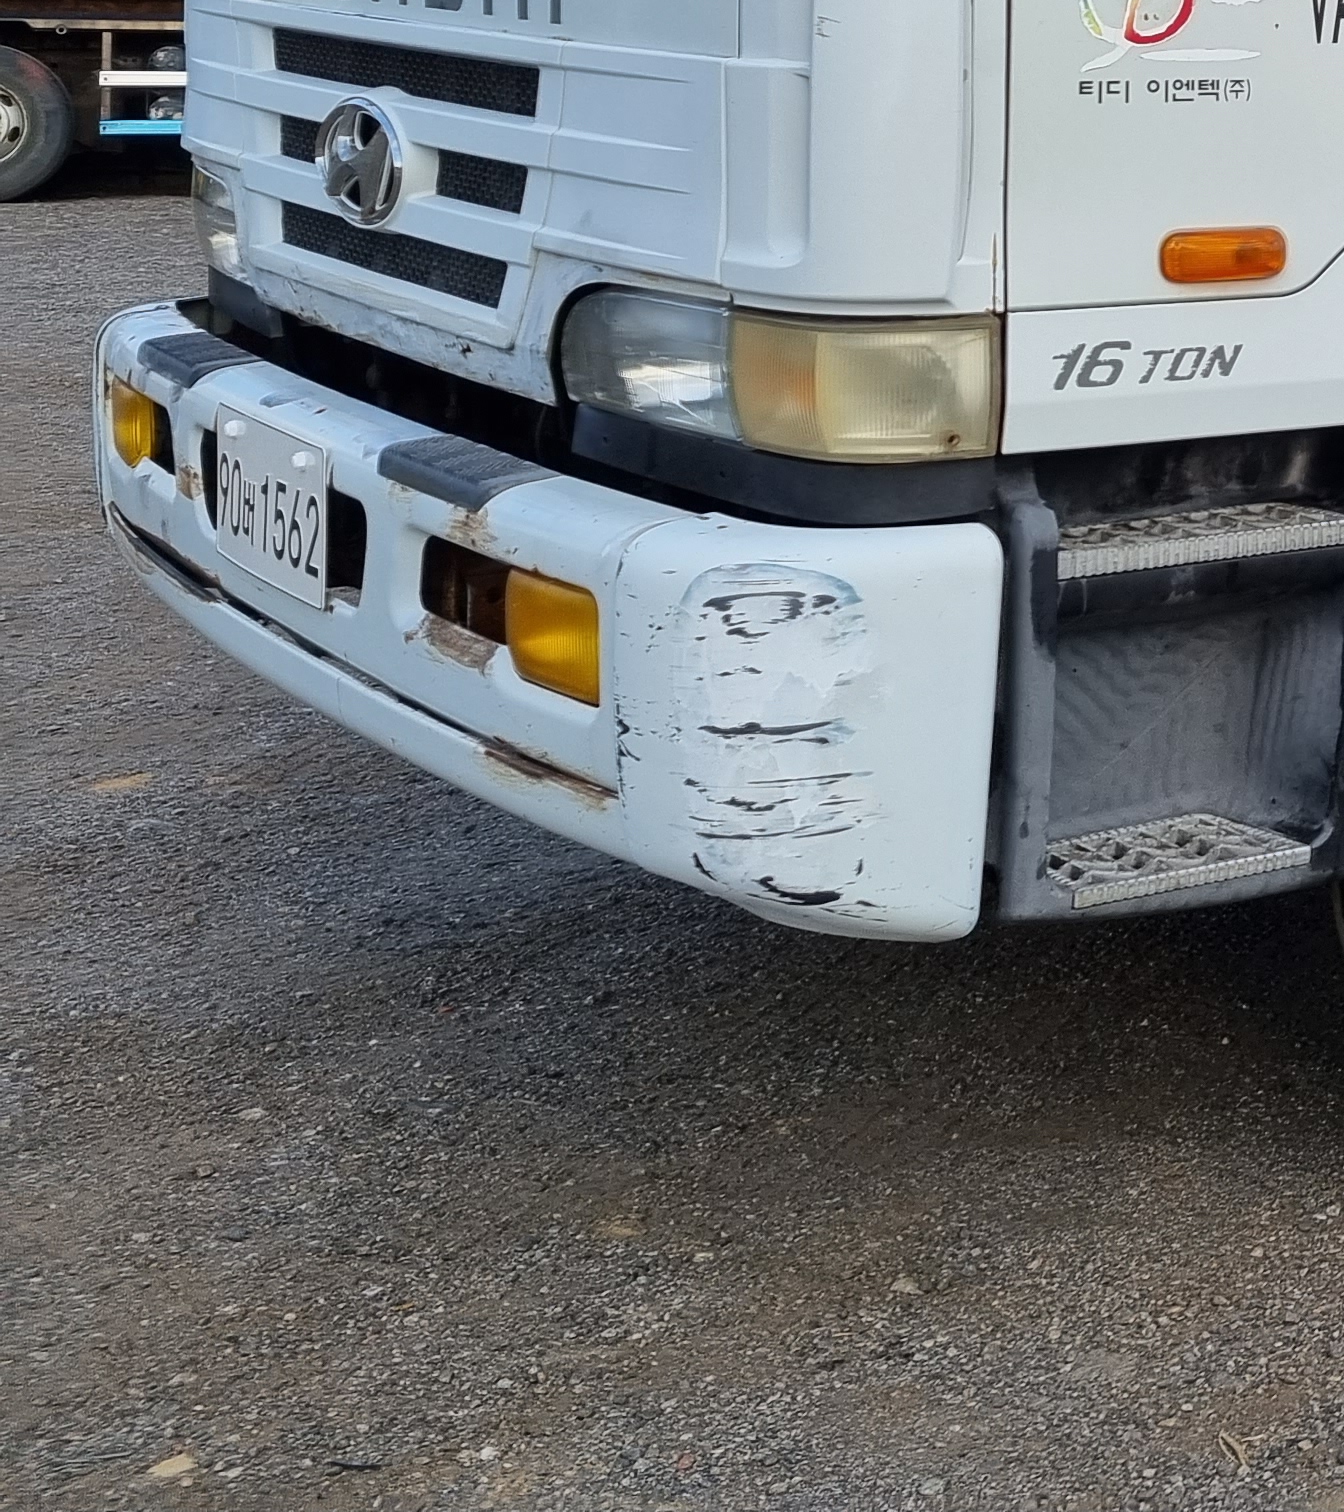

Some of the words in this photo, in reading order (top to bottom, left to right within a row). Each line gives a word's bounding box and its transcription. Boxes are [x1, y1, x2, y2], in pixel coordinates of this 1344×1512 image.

[1077, 79, 1131, 104] 티디
[1146, 77, 1252, 103] 이엔텍(주)
[1052, 340, 1133, 391] 16
[1138, 343, 1244, 385] TON
